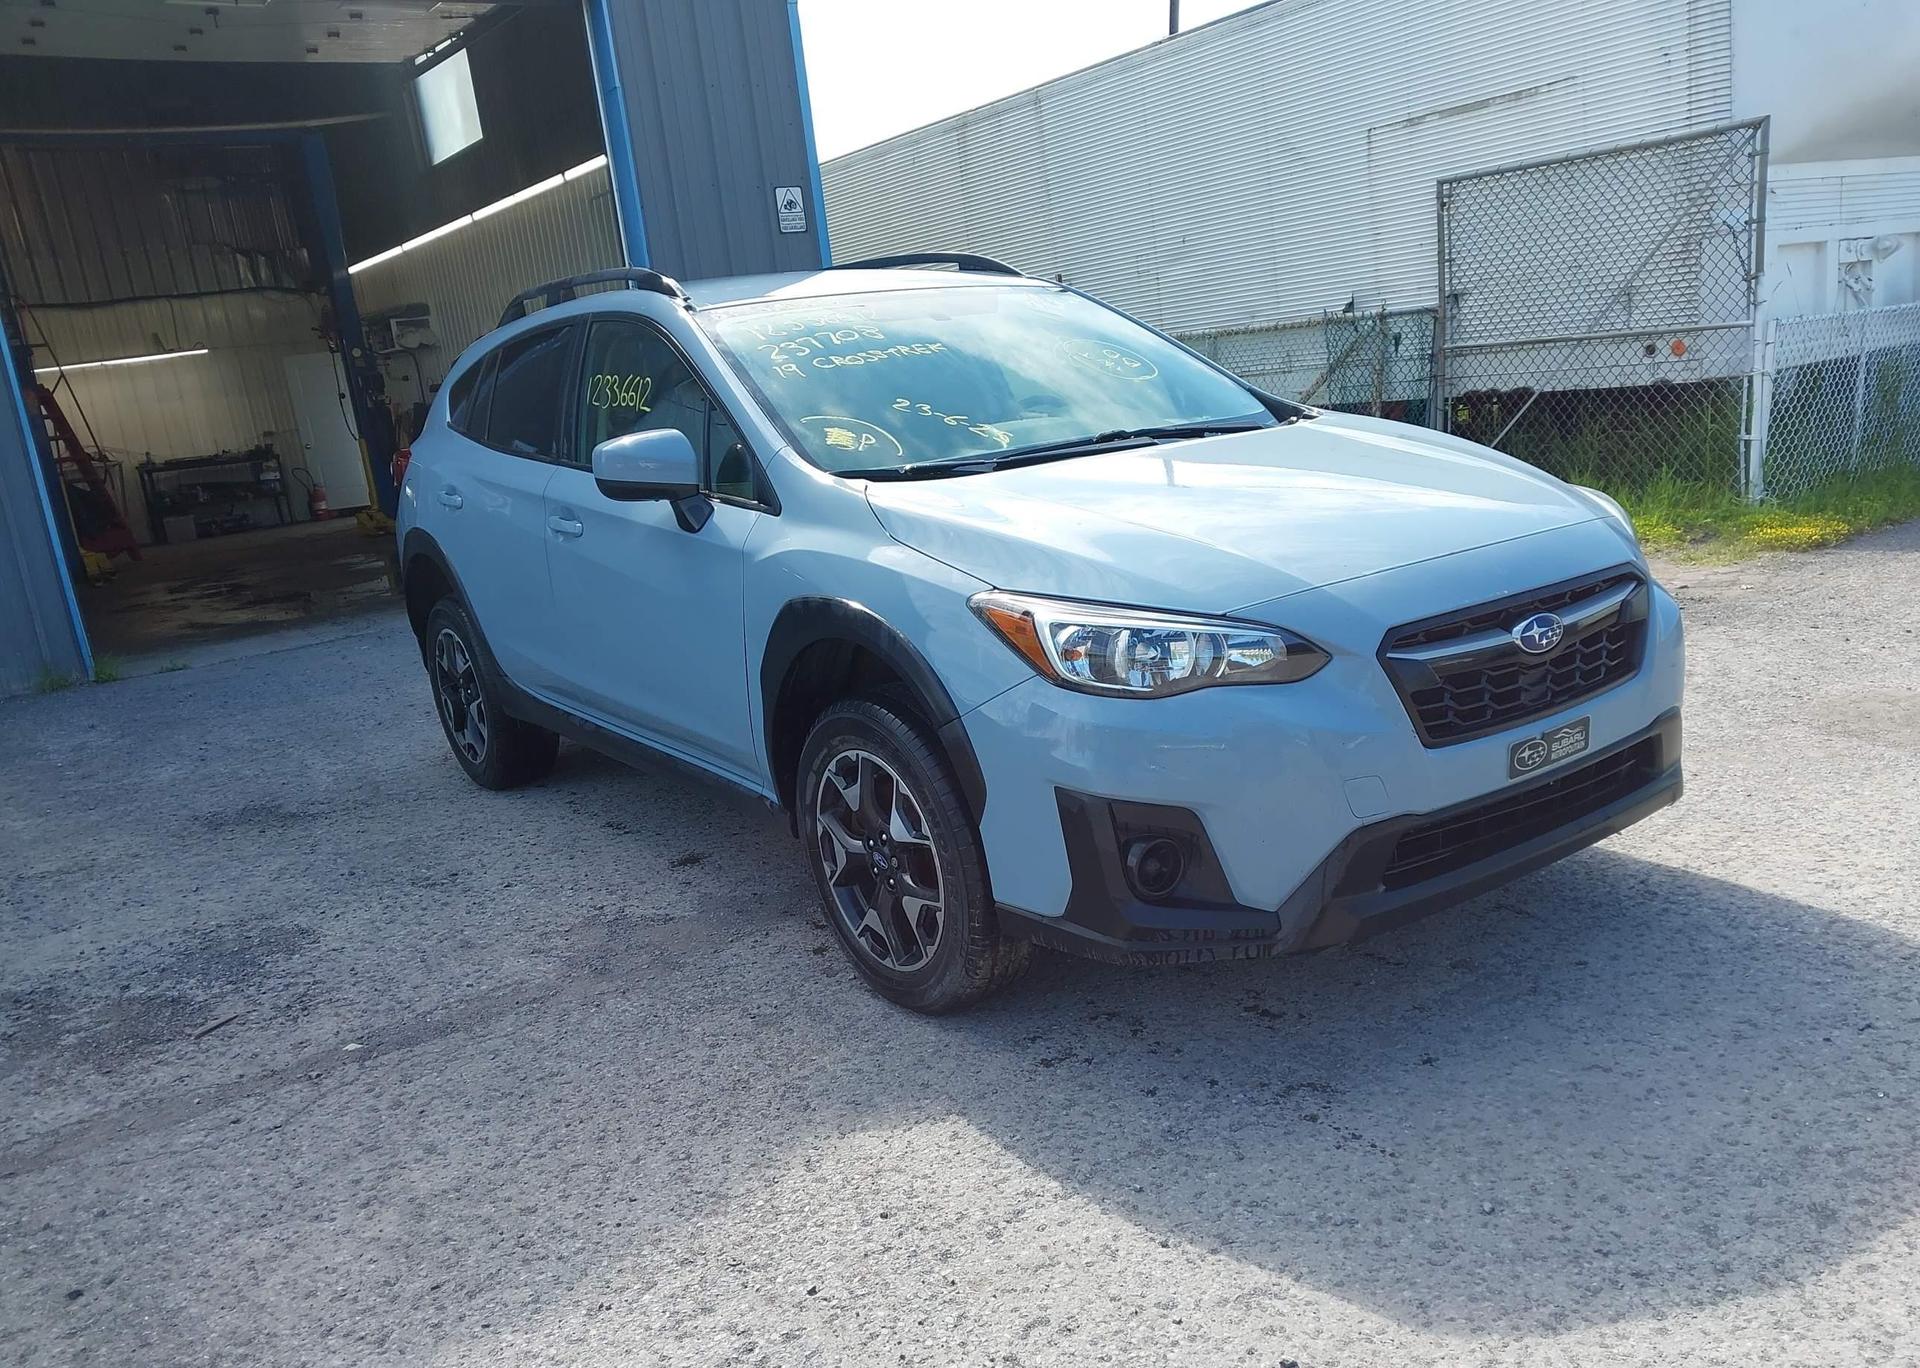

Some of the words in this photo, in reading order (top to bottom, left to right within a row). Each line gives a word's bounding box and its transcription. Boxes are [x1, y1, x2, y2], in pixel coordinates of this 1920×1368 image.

[772, 363, 807, 379] 19
[586, 373, 652, 412] 12336612
[1551, 730, 1586, 751] SUBARU
